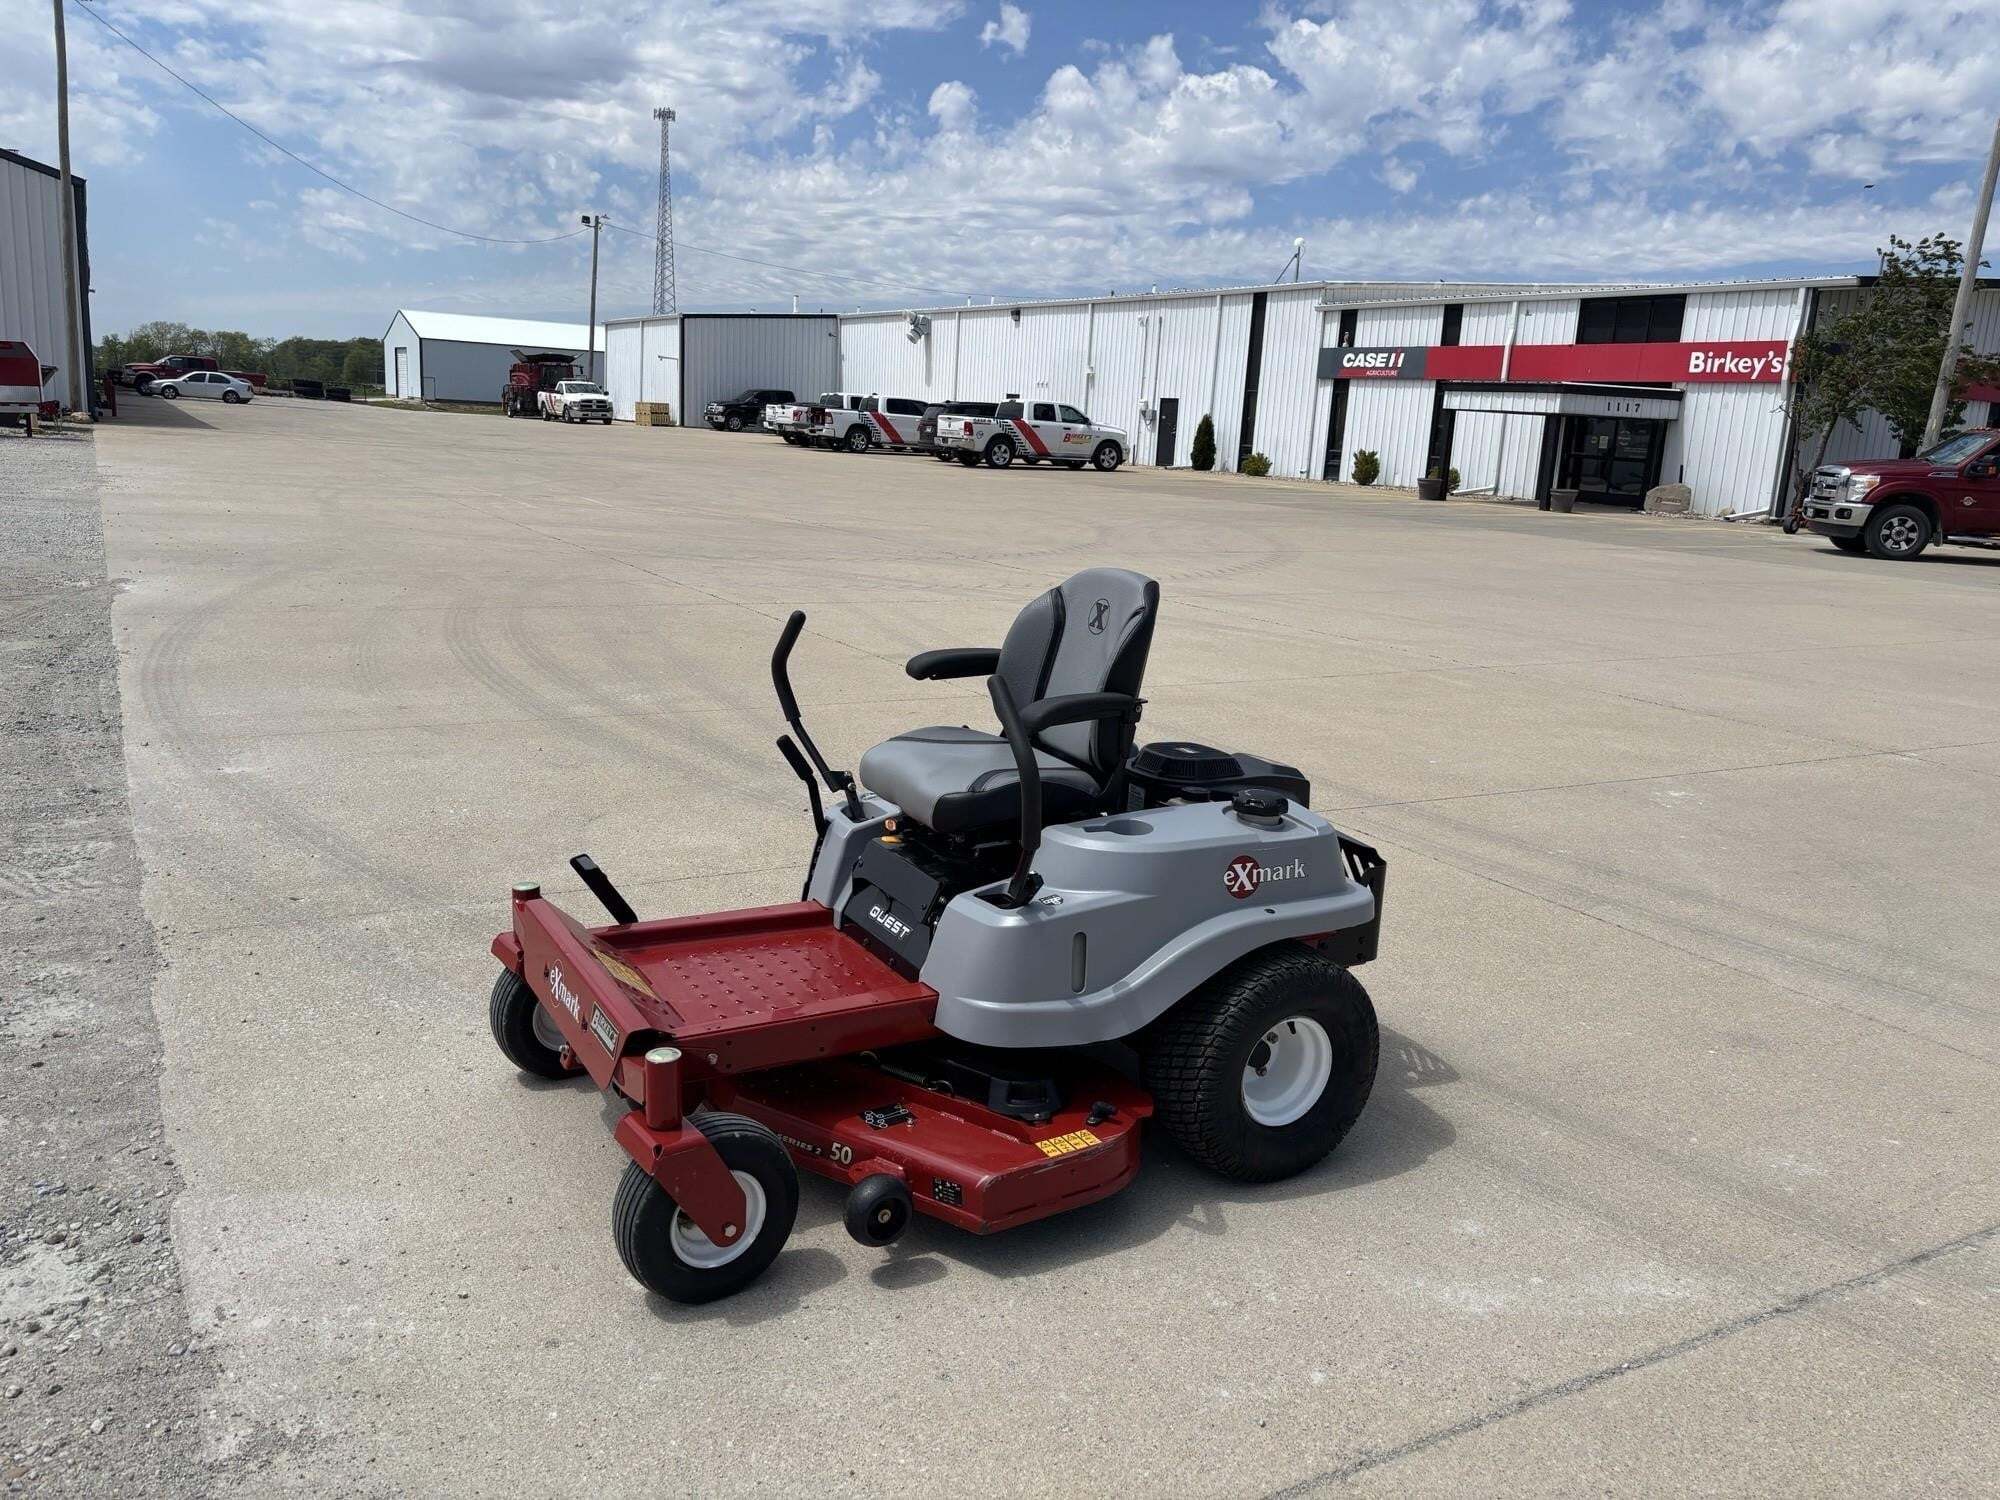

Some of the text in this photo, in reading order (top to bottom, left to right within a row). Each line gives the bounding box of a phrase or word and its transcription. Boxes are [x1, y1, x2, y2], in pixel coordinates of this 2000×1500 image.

[1688, 350, 1783, 380] Birkey's
[1607, 401, 1641, 413] 1117
[869, 905, 911, 938] QUEST
[829, 1141, 853, 1166] 50
